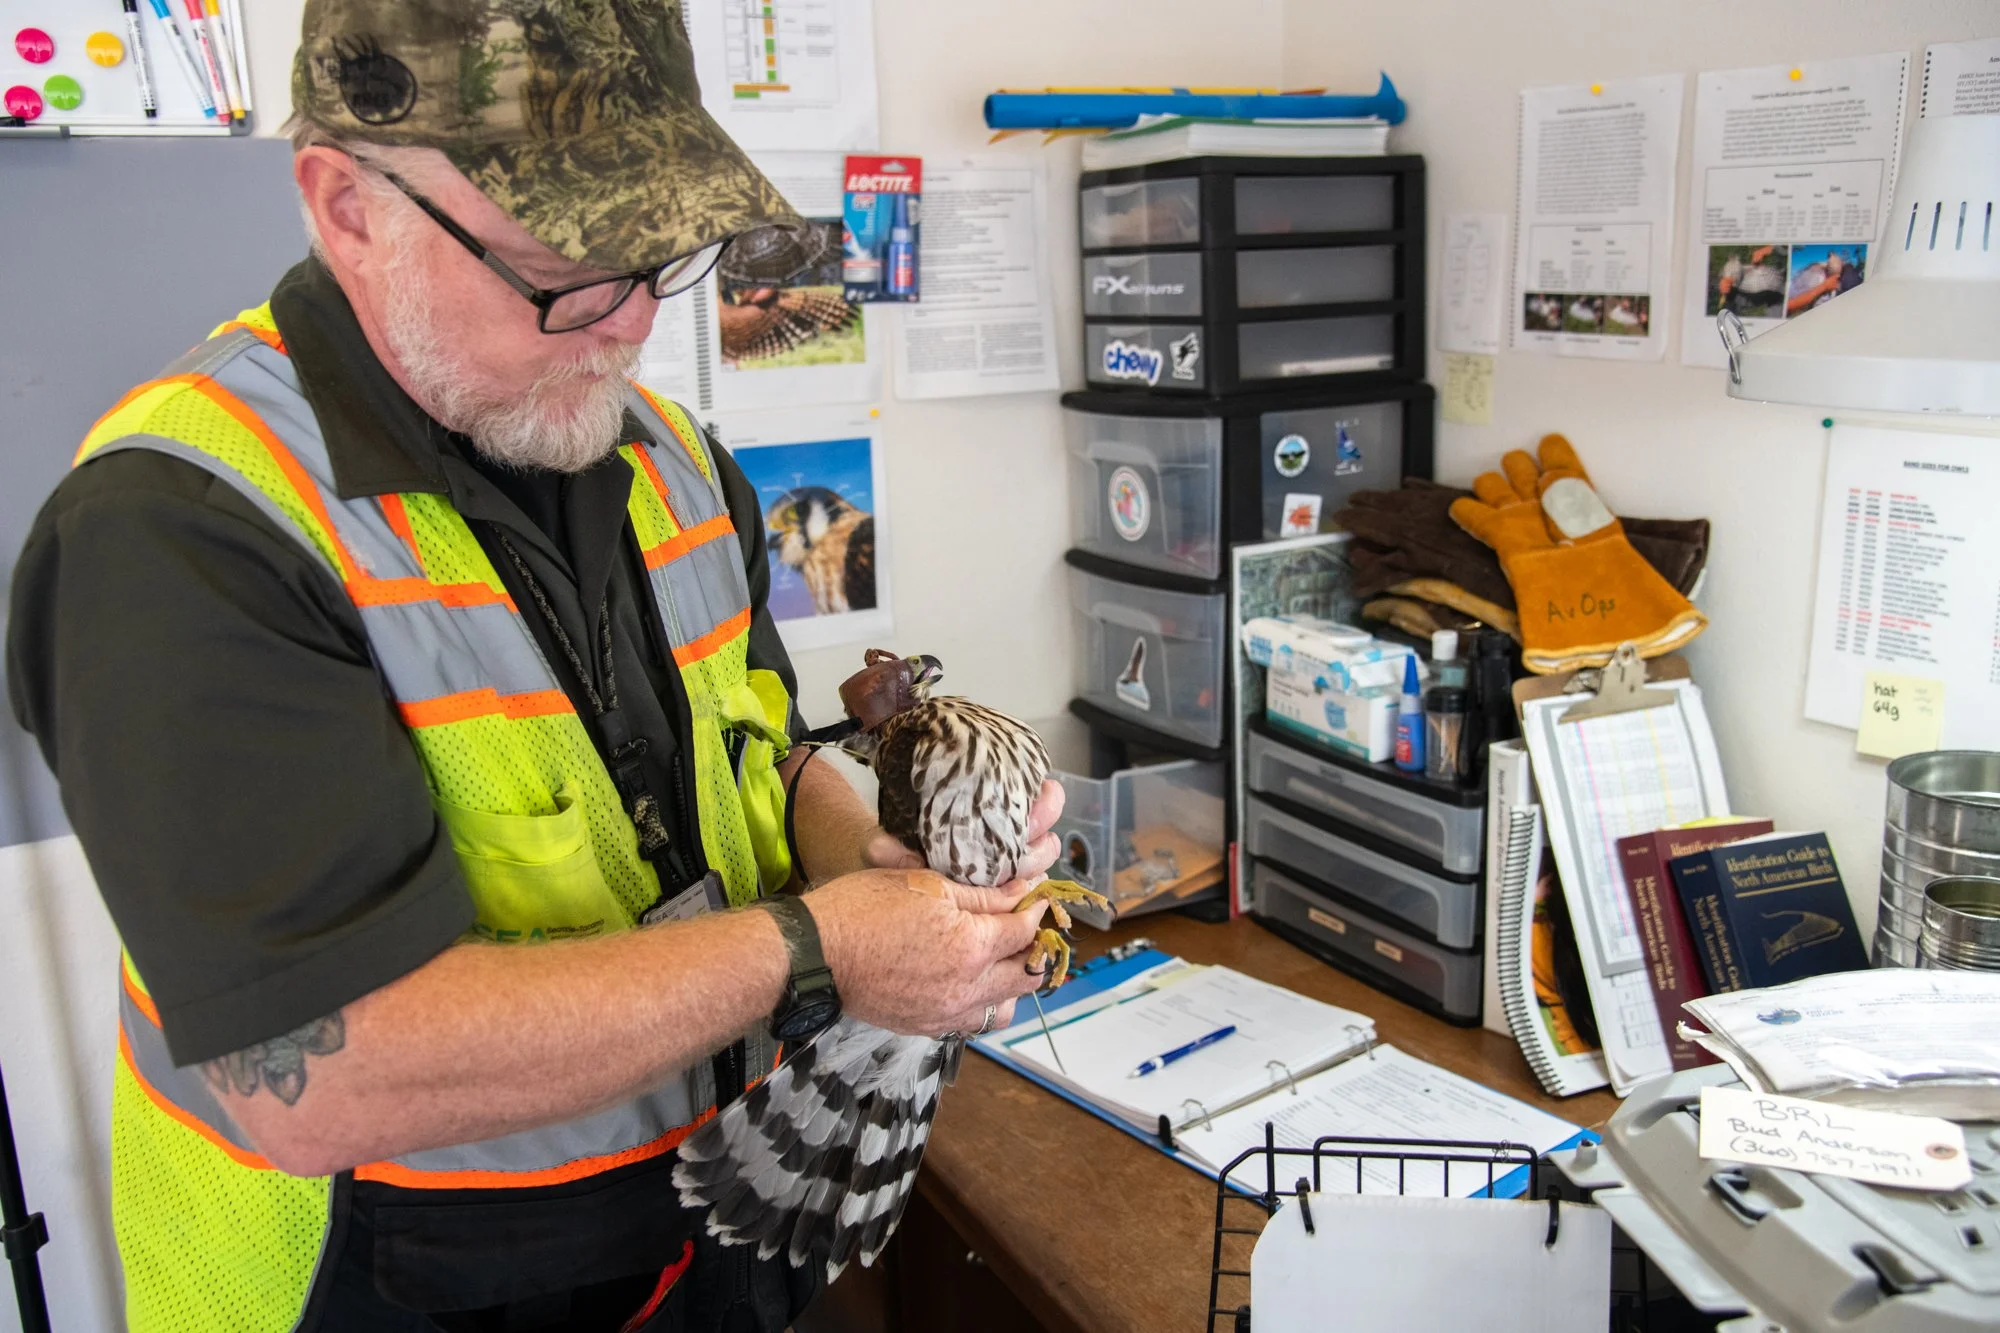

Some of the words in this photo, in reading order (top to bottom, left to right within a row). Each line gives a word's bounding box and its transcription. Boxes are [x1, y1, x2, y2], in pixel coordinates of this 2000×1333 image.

[846, 175, 914, 192] LOCTITE
[1105, 345, 1160, 381] chewy
[1873, 681, 1899, 698] hat
[1873, 700, 1900, 721] 64g
[1725, 854, 1787, 873] Identification
[1786, 845, 1817, 863] Guide
[1816, 847, 1830, 858] to
[1731, 871, 1760, 889] North
[1762, 868, 1808, 884] American
[1807, 860, 1834, 877] Birds
[1727, 1117, 1782, 1138] Bud
[1796, 1129, 1913, 1162] Anderson
